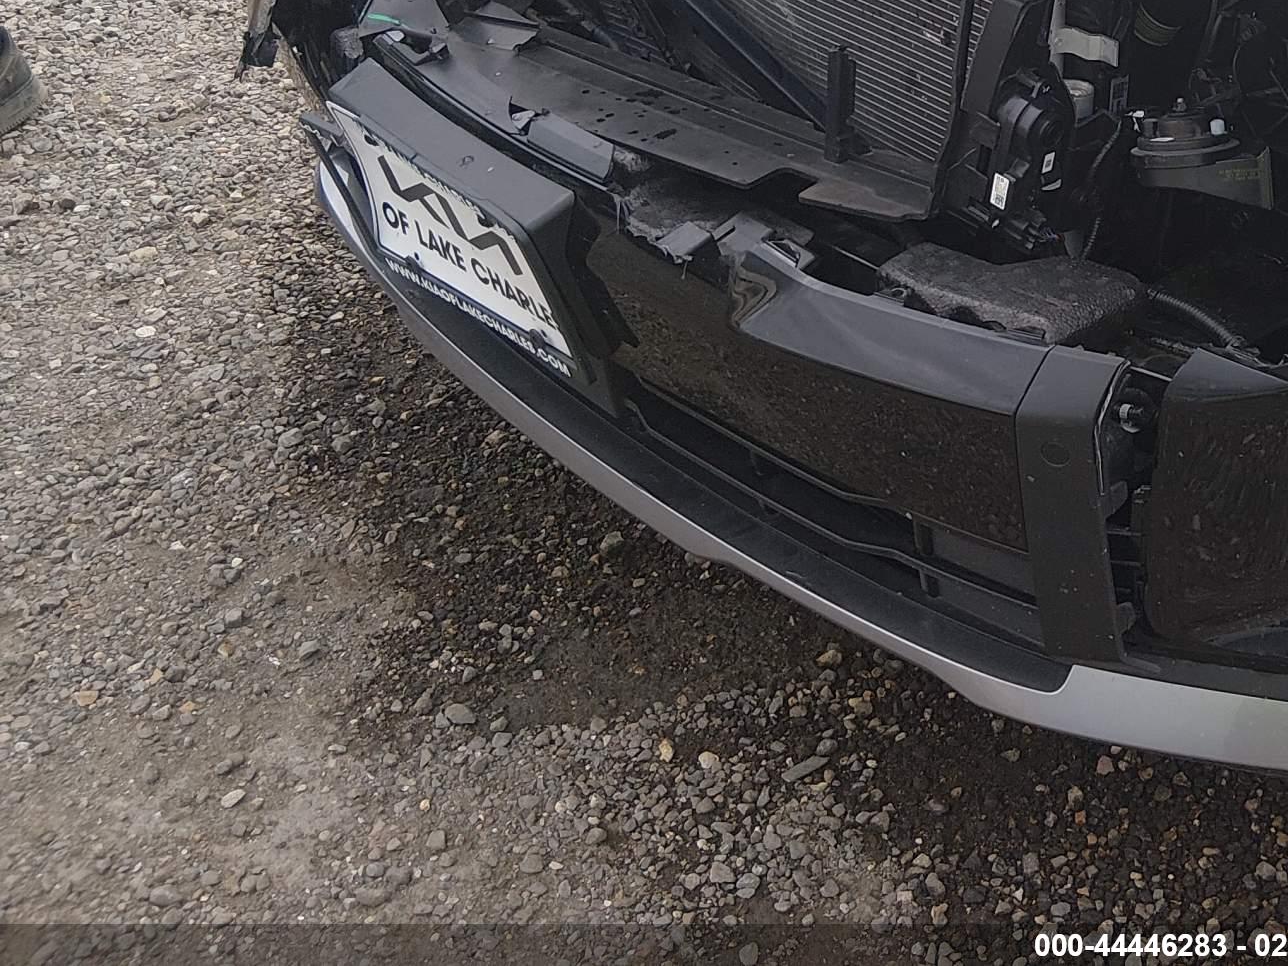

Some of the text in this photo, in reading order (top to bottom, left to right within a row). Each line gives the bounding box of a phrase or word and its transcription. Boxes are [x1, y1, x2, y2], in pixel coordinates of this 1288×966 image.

[382, 201, 560, 330] OF LAKE CHARLE
